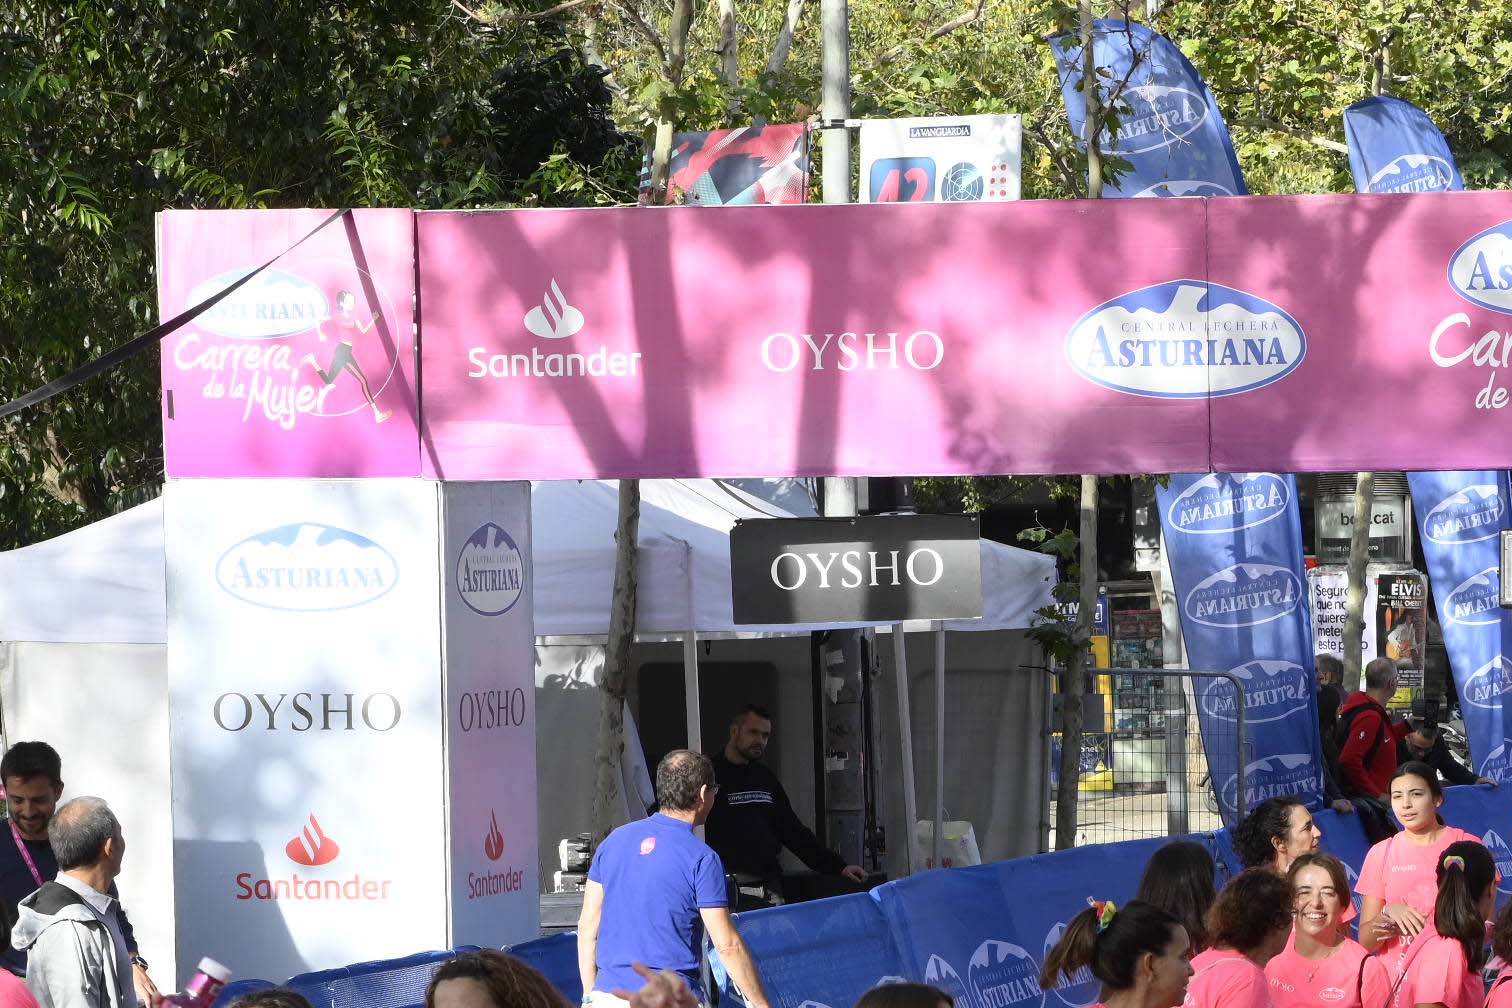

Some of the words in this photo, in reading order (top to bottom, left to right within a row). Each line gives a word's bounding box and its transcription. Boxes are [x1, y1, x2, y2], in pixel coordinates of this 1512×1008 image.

[911, 128, 920, 138] LA
[920, 126, 969, 137] VANGUARDIA
[1120, 321, 1196, 333] CENTRAL
[1203, 320, 1280, 332] LECHERA
[174, 332, 292, 379] Carrera
[469, 346, 641, 378] Santander
[761, 331, 944, 372] OYSHO
[1086, 325, 1287, 368] ASTURIANA
[203, 372, 225, 398] de
[229, 366, 245, 398] la
[243, 368, 336, 429] Mujer
[1475, 371, 1509, 410] de
[231, 557, 385, 589] ASTURIANA
[462, 558, 520, 594] ASTURIANA
[771, 547, 944, 591] OYSHO
[1316, 600, 1333, 613] que
[1391, 583, 1422, 597] ELVIS
[1319, 640, 1337, 651] este
[213, 692, 402, 732] OYSHO
[460, 687, 526, 733] OYSHO
[236, 872, 392, 901] Santander
[468, 866, 524, 900] Santander
